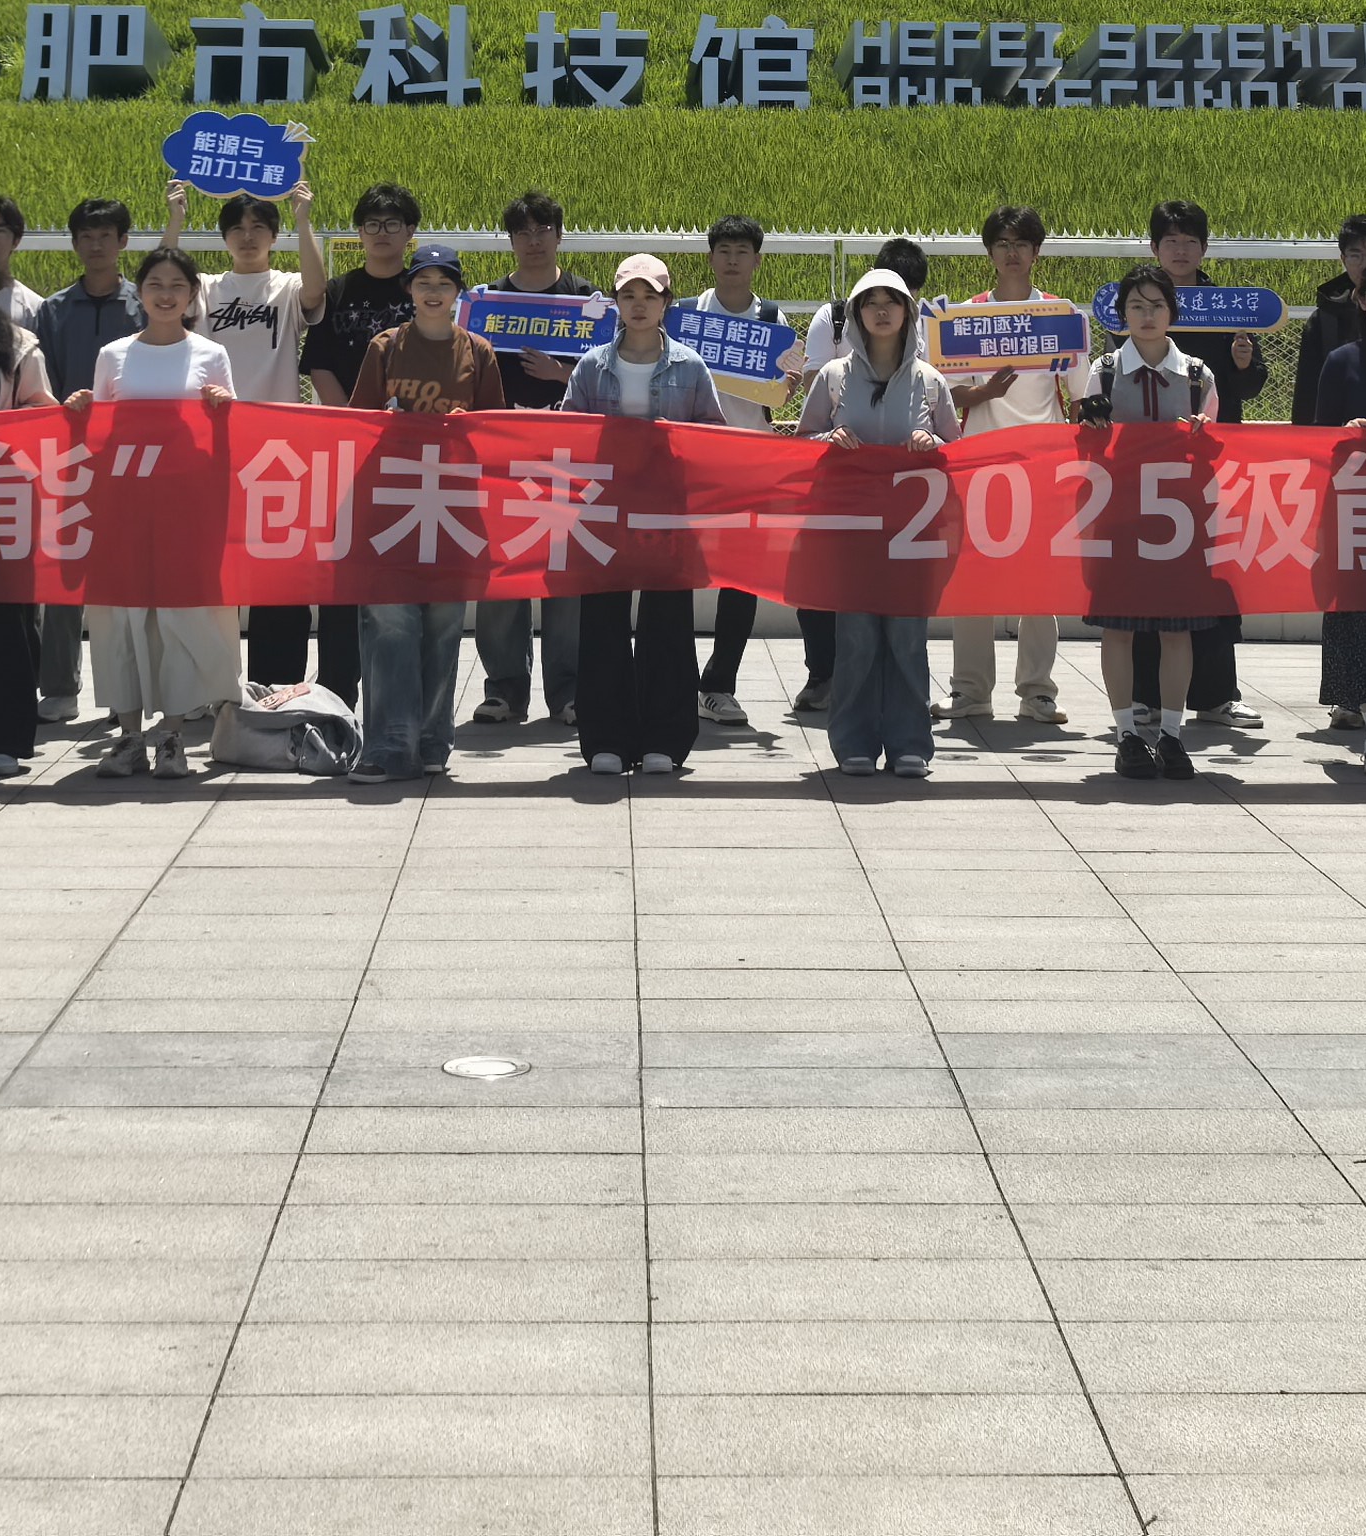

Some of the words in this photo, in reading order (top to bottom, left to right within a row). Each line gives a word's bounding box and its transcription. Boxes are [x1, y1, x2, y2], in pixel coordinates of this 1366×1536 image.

[852, 21, 1062, 67] HEFEI
[193, 131, 264, 158] 能源与
[189, 155, 284, 185] 动力工程
[483, 314, 594, 338] 能动向未来
[680, 313, 771, 347] 青春能动
[953, 315, 1031, 336] 能动逐光
[980, 335, 1058, 355] 科创报国
